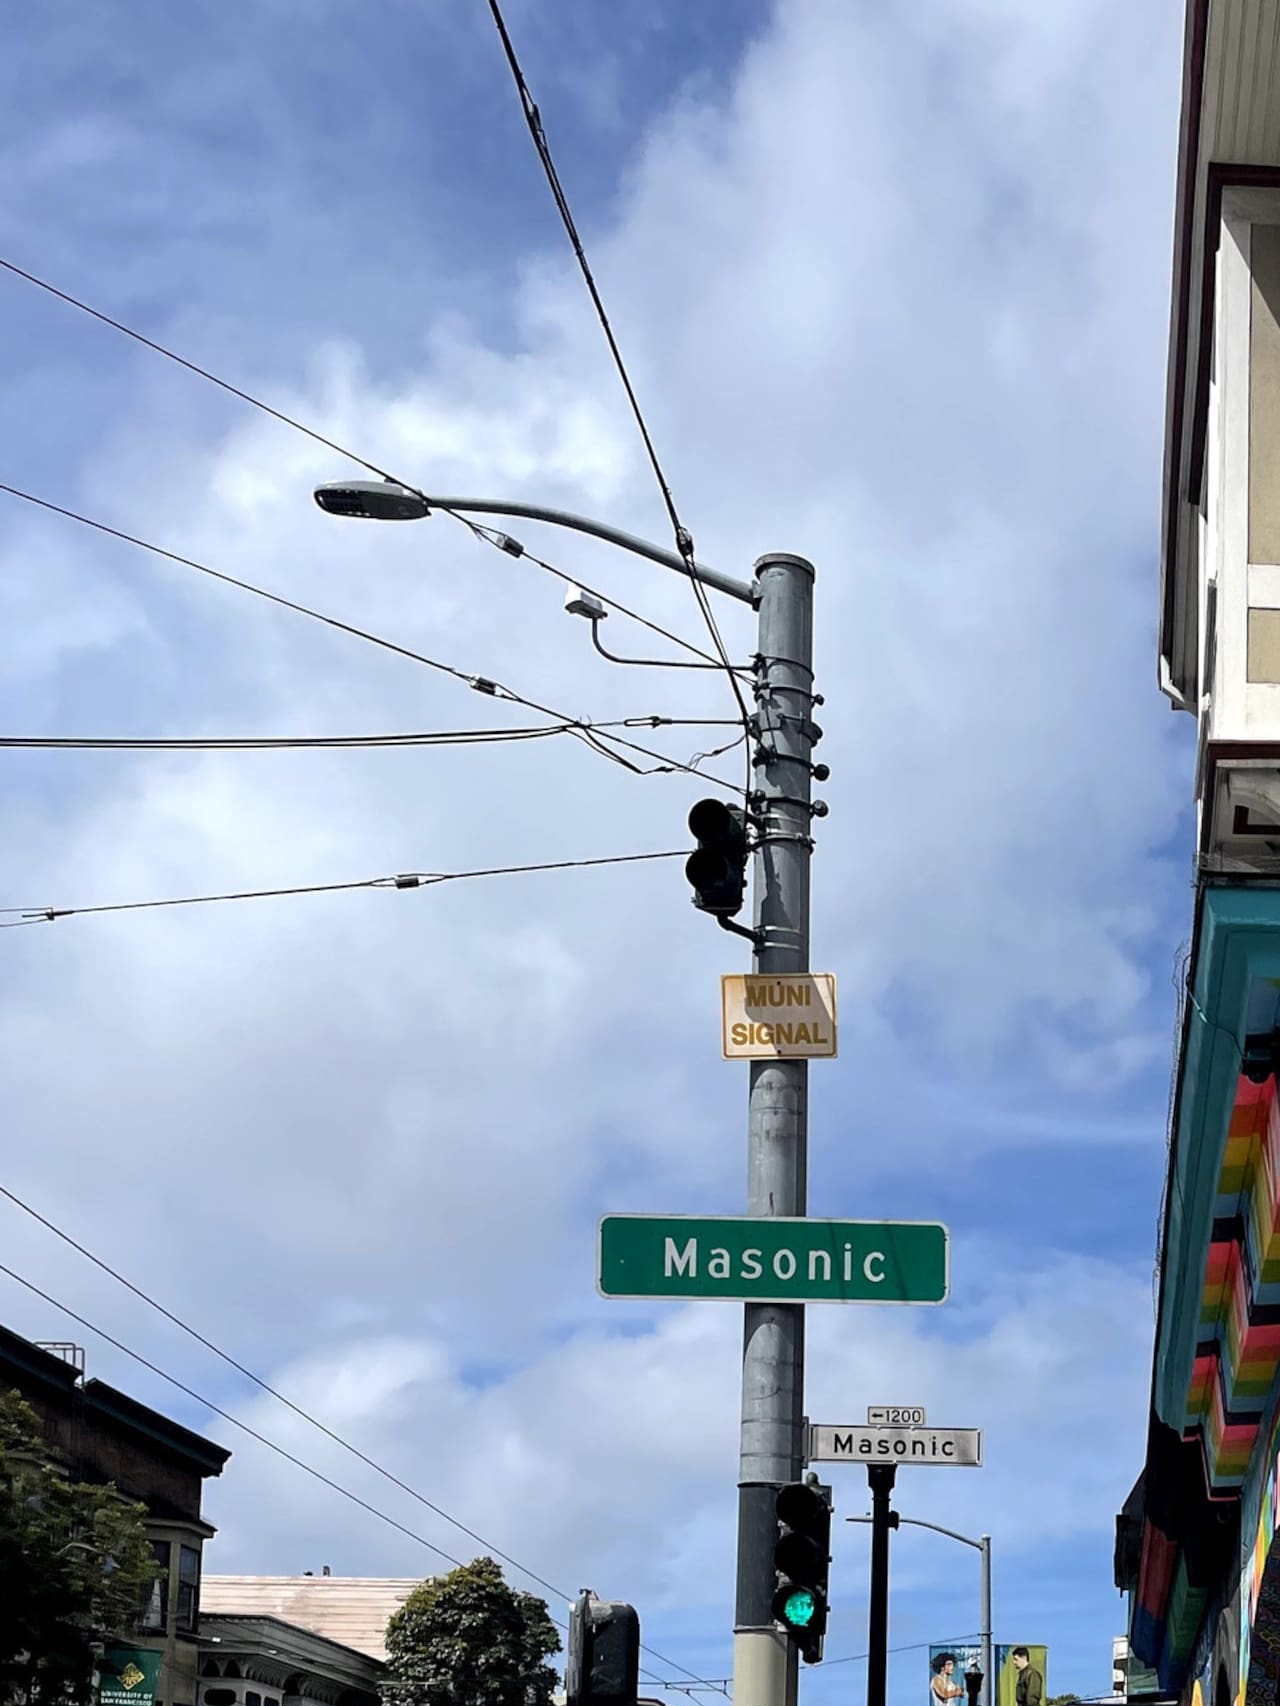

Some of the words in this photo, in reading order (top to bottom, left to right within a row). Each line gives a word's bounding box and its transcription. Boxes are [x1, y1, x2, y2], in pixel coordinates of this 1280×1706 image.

[745, 983, 812, 1008] MUNI
[730, 1022, 828, 1046] SIGNAL
[663, 1236, 887, 1283] Masonic
[884, 1408, 922, 1424] 1200
[833, 1434, 955, 1458] Masonic
[100, 1689, 142, 1698] UNIVERSITY
[115, 1697, 152, 1706] FRANCISCO
